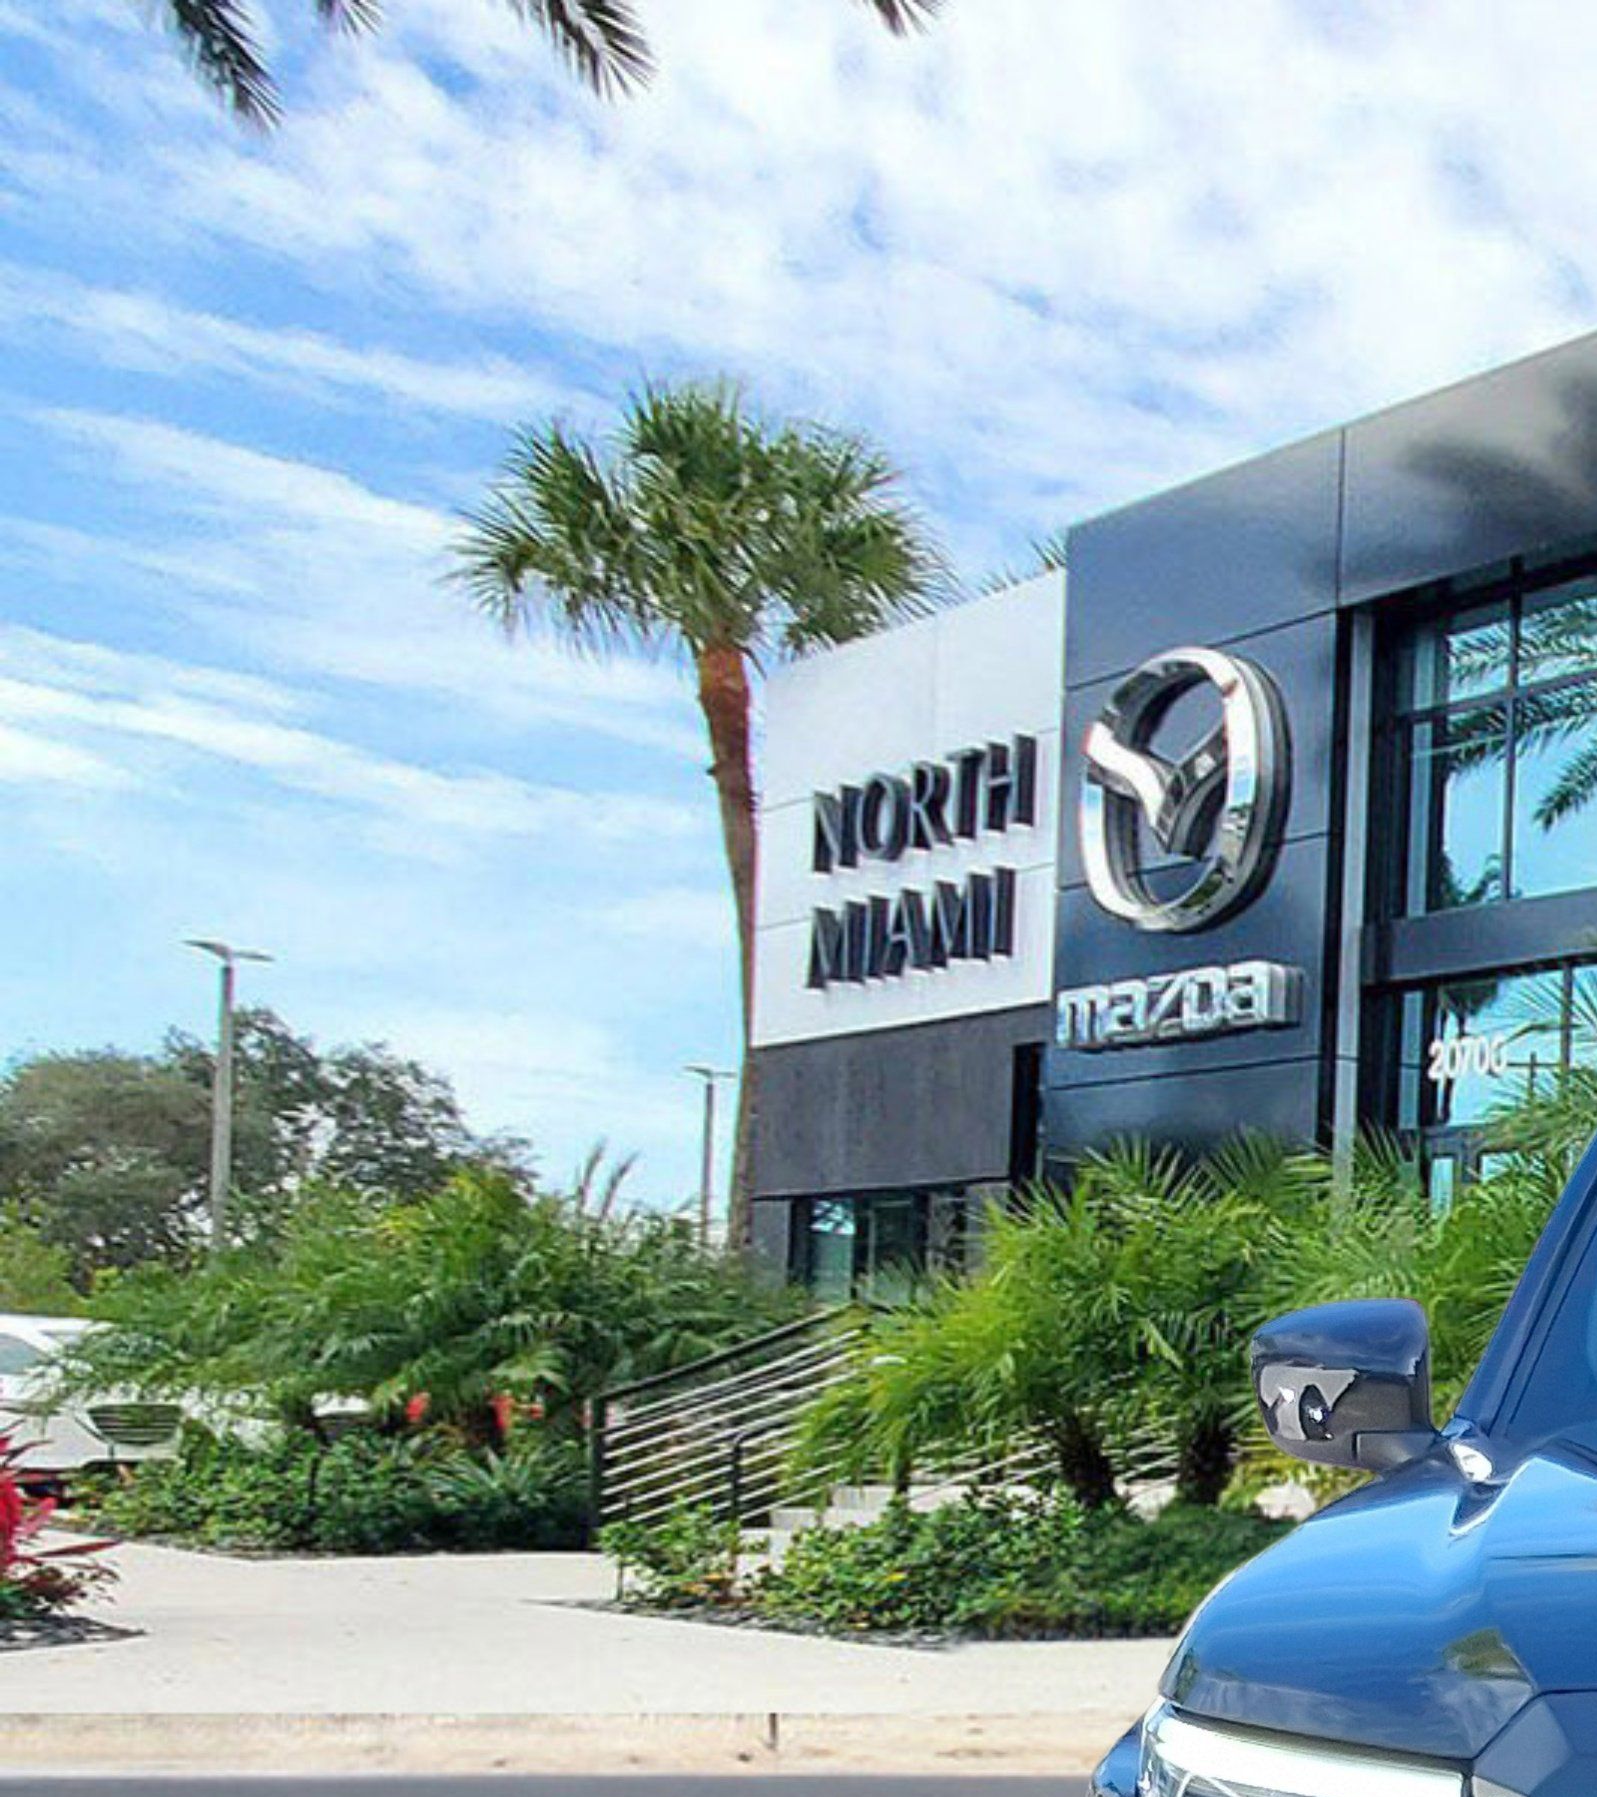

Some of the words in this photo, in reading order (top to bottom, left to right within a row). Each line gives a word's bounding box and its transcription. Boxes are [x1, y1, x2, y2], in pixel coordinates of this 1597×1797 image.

[812, 733, 1037, 875] NORTH
[806, 866, 1016, 989] MIAMI
[1056, 962, 1290, 1048] mazda
